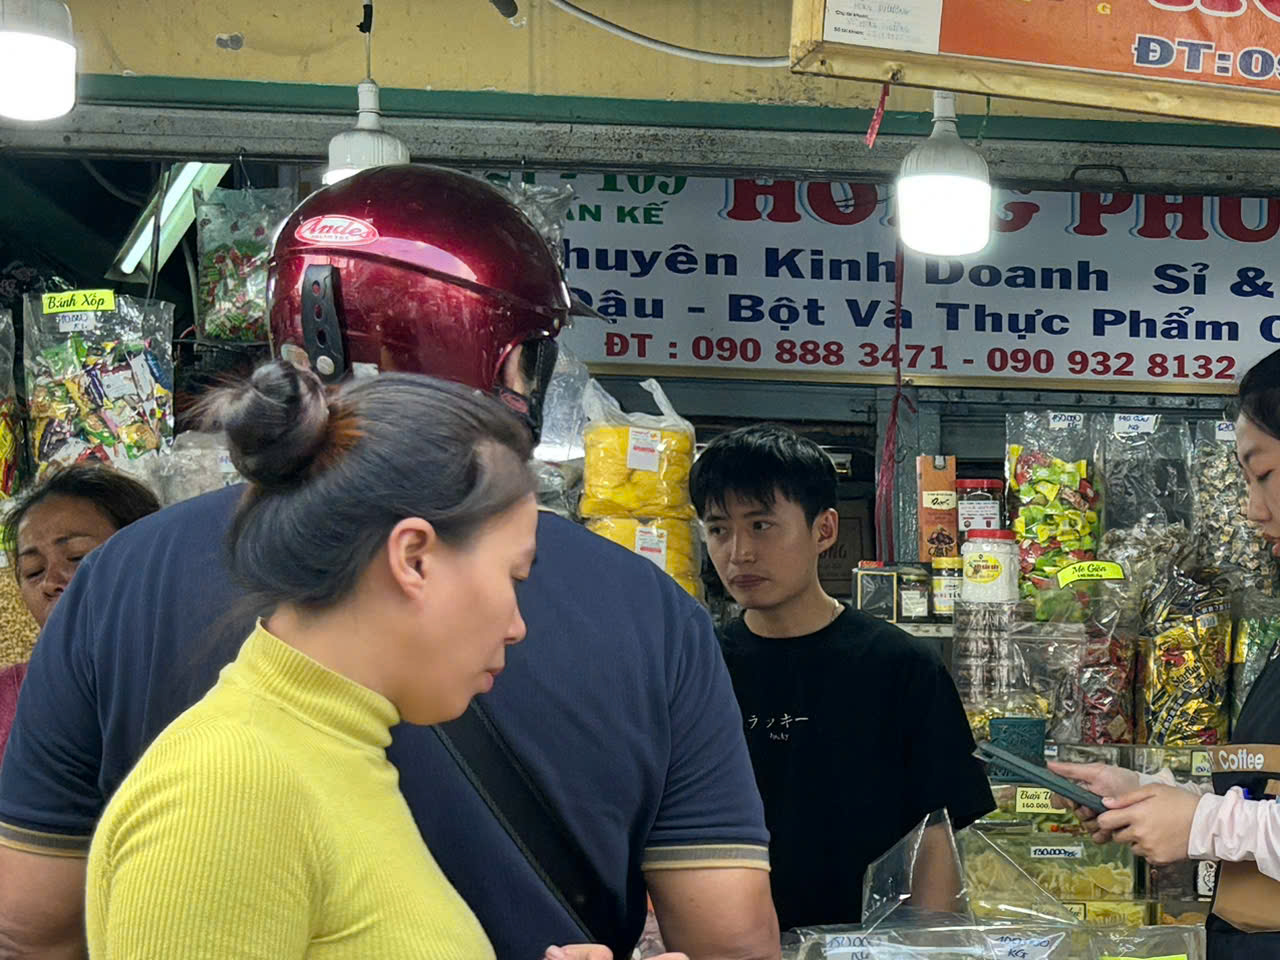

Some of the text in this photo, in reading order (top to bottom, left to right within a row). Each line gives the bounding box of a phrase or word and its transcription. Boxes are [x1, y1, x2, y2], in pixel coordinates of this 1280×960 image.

[563, 238, 738, 278] huyên
[764, 246, 897, 284] Kinh
[924, 254, 1109, 294] Doanh
[1229, 265, 1276, 300] &
[728, 293, 826, 332] Bột
[844, 299, 914, 330] Và
[935, 301, 1070, 340] Thực
[1093, 305, 1240, 342] Phẩm
[604, 333, 653, 360] ĐT
[691, 335, 762, 363] 090
[775, 338, 845, 365] 888
[858, 343, 948, 371] 3471
[987, 346, 1055, 375] 090
[1067, 349, 1135, 378] 932
[1147, 352, 1236, 381] 8132
[1219, 749, 1266, 770] Coffee
